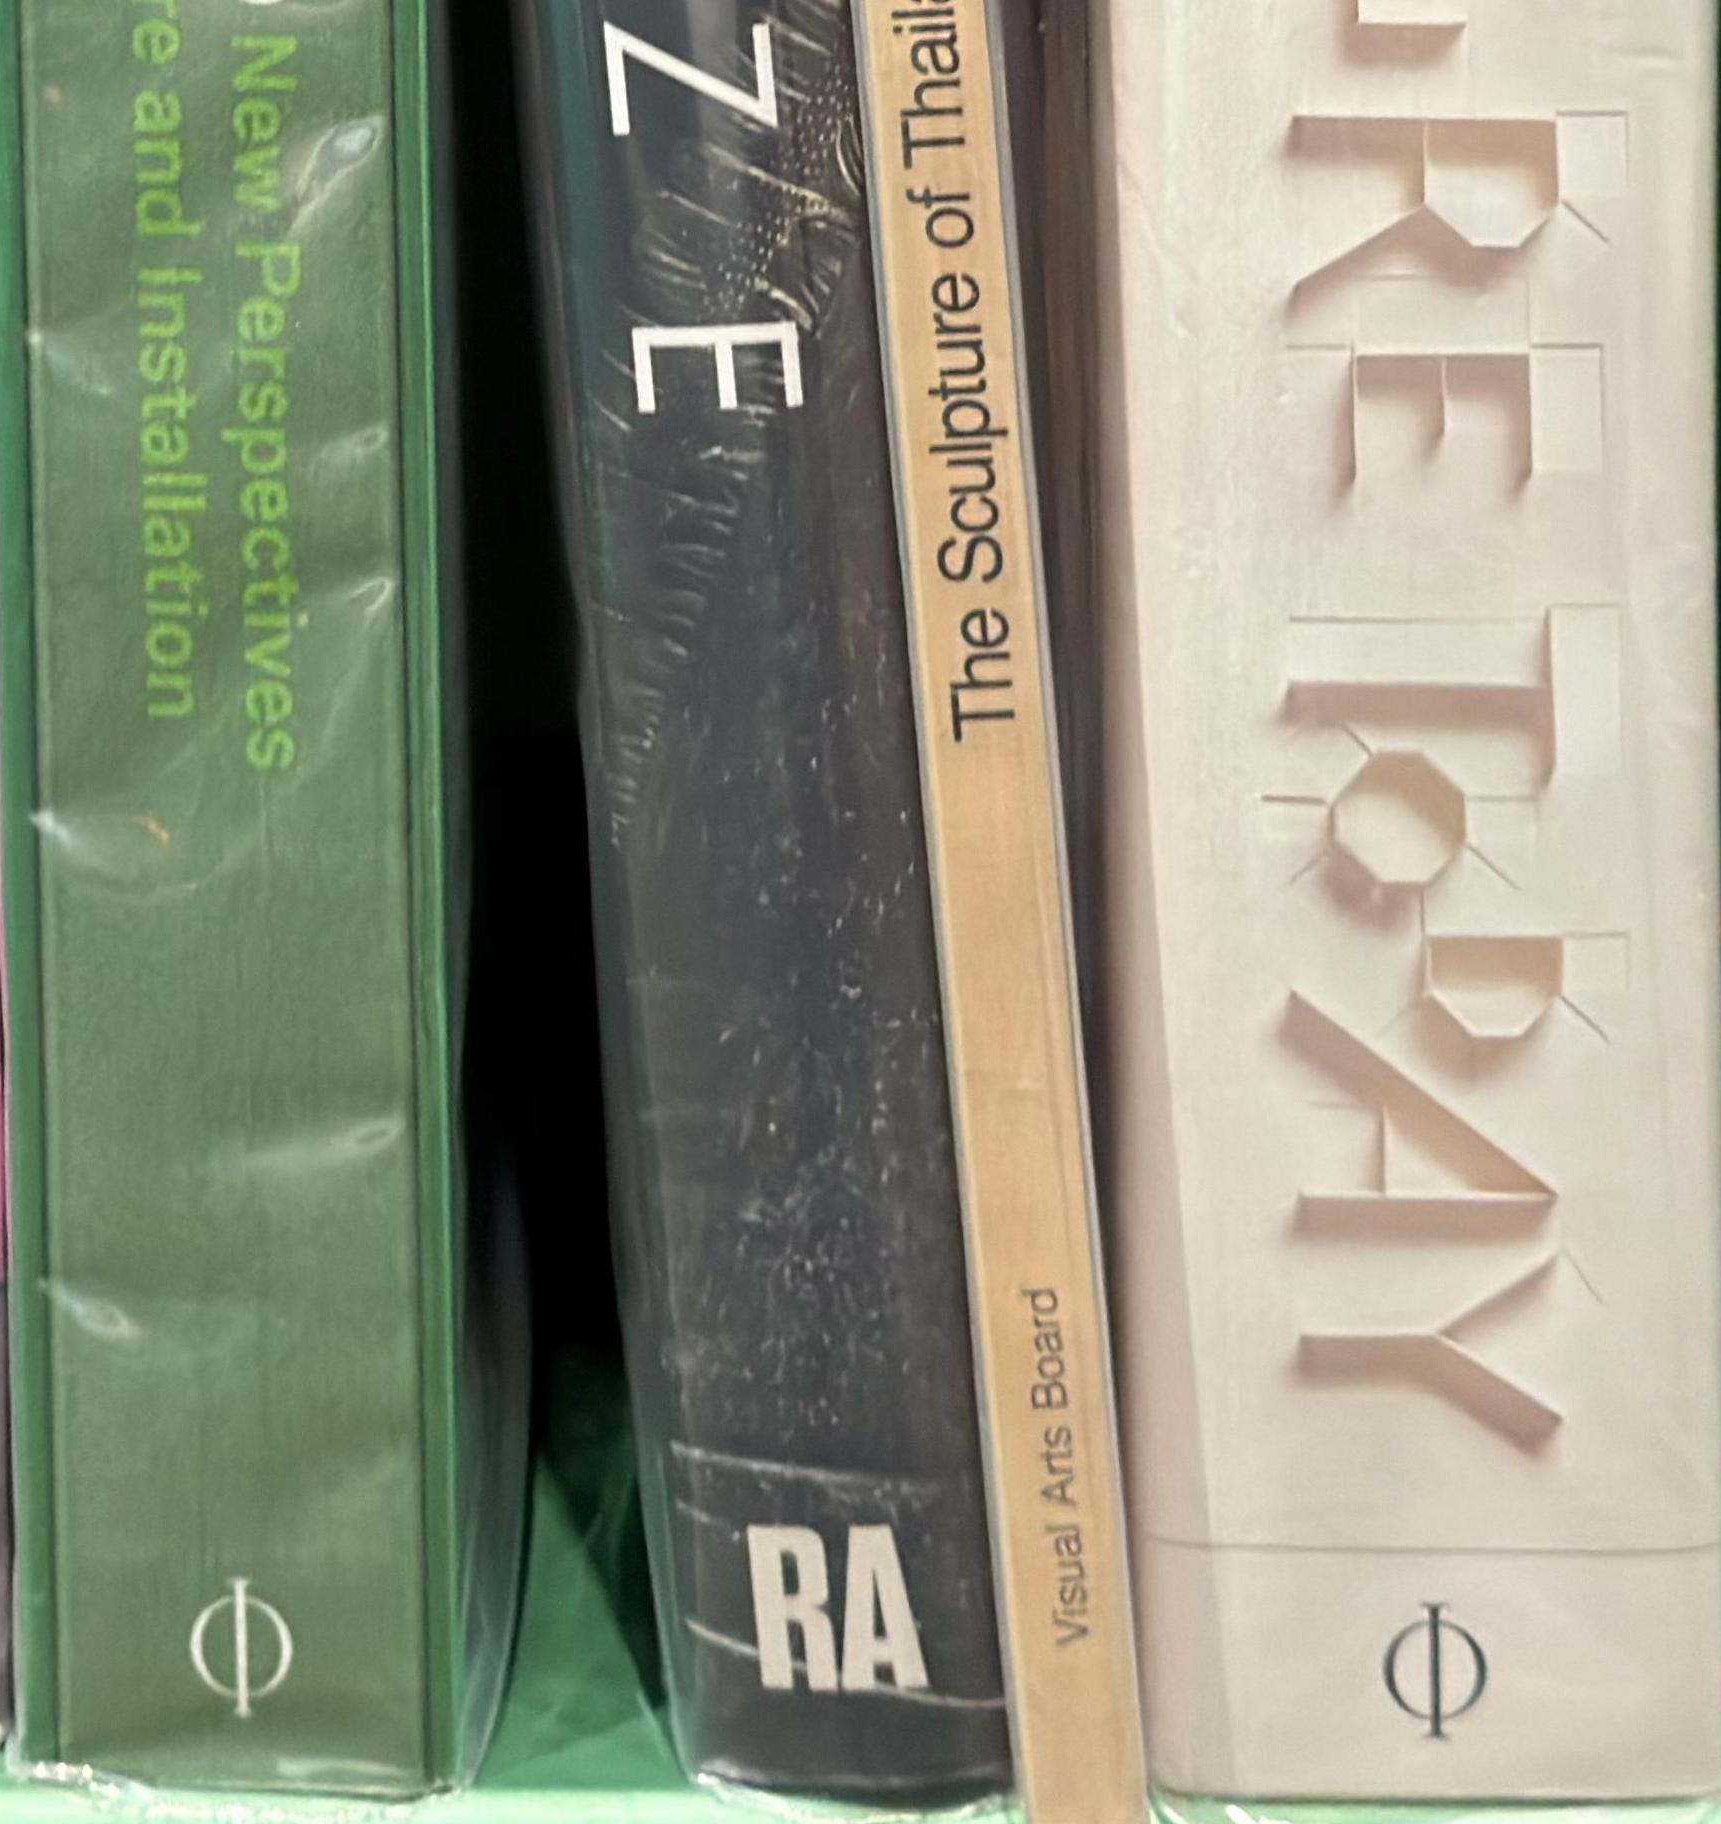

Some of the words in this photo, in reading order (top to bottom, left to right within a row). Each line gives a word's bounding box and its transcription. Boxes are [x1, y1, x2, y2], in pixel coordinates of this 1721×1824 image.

[132, 88, 201, 239] and
[229, 32, 300, 213] New
[906, 186, 975, 250] of
[135, 266, 210, 719] Installation
[927, 271, 1009, 585] Sculpture
[221, 240, 311, 771] Perspectives
[948, 606, 1015, 744] The
[1022, 1286, 1070, 1412] Board
[1040, 1423, 1074, 1507] Arts
[745, 1522, 931, 1694] RA
[1046, 1525, 1090, 1649] Visual
